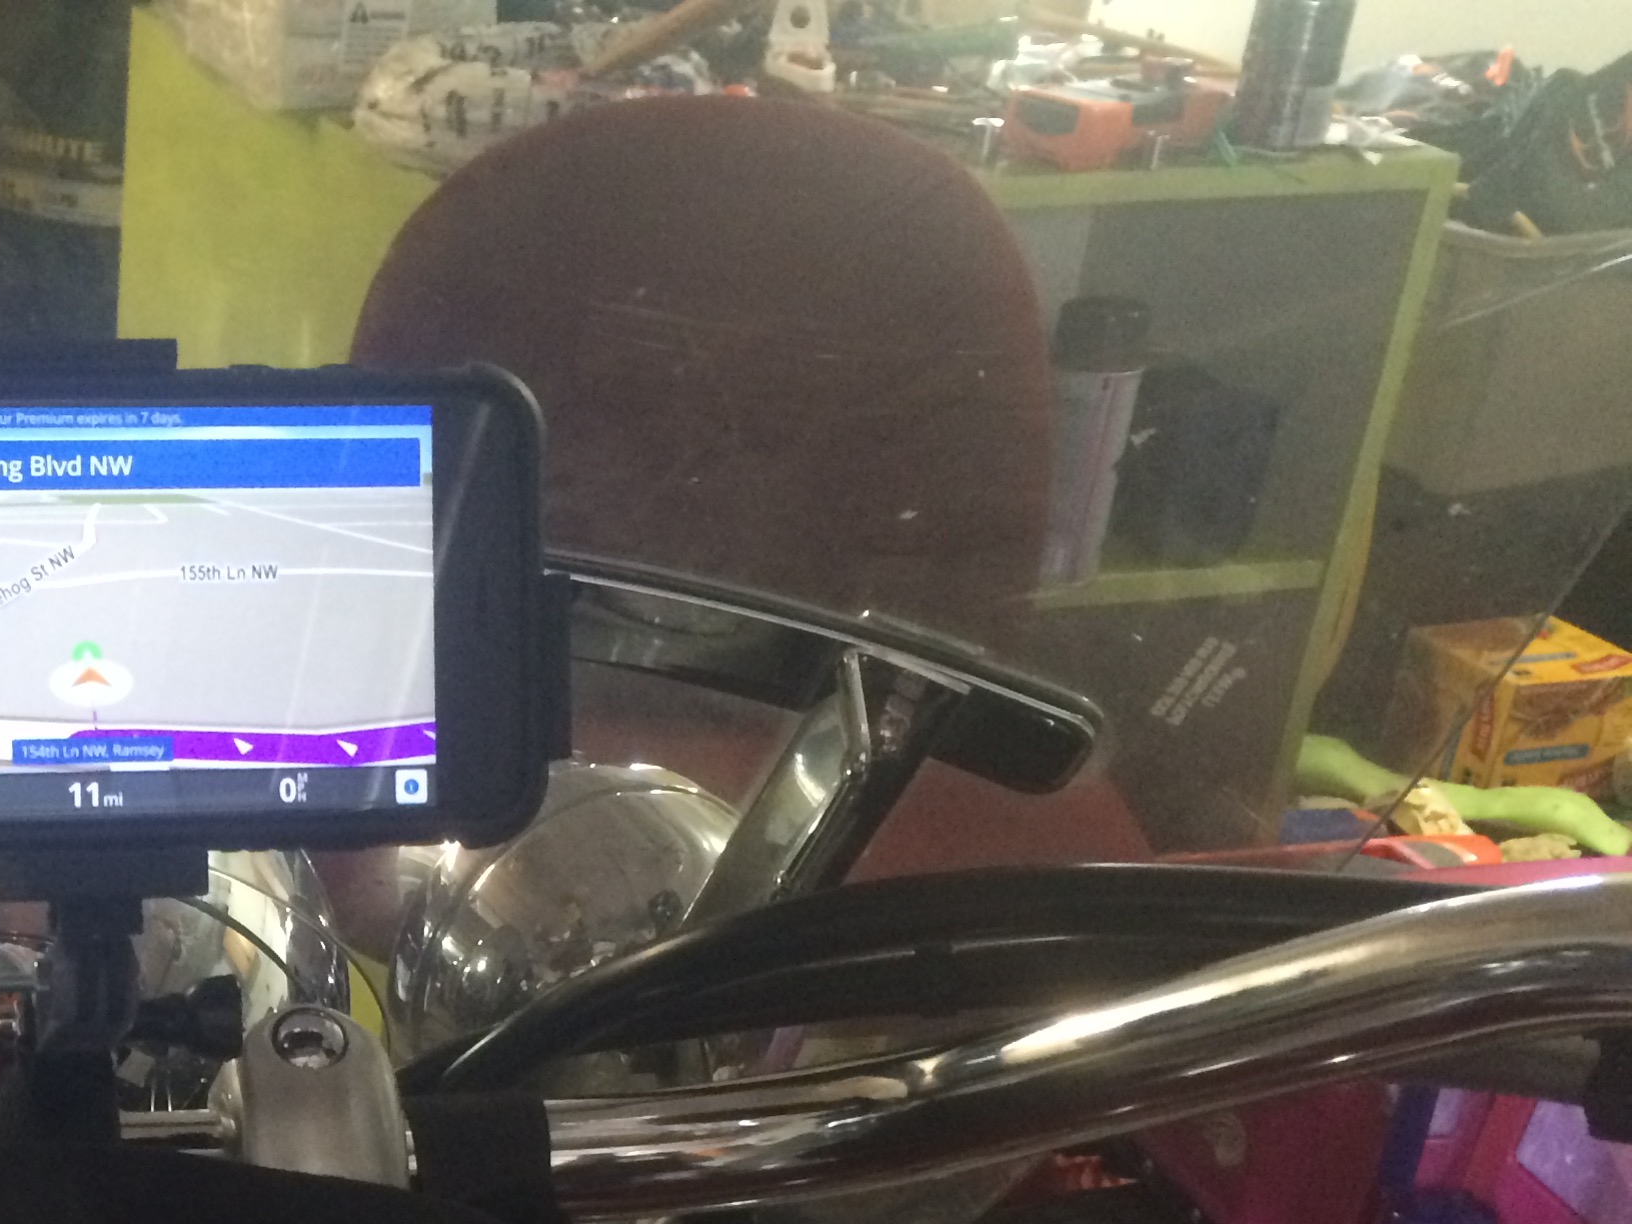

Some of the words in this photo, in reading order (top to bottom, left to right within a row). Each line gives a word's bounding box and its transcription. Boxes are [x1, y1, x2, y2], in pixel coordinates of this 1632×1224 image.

[17, 411, 74, 425] Premium
[76, 412, 123, 427] expires
[126, 411, 137, 424] in
[140, 411, 149, 424] 7
[30, 454, 83, 477] Blvd
[89, 455, 133, 477] NW
[30, 563, 50, 582] St
[47, 545, 76, 571] NW
[180, 565, 221, 581] 155th
[226, 565, 246, 580] Ln
[251, 564, 278, 580] NW
[21, 745, 60, 760] 154th
[63, 745, 80, 759] Ln
[112, 744, 165, 761] Ramsey
[67, 781, 101, 810] 11
[103, 792, 124, 809] mi
[279, 777, 297, 803] 0
